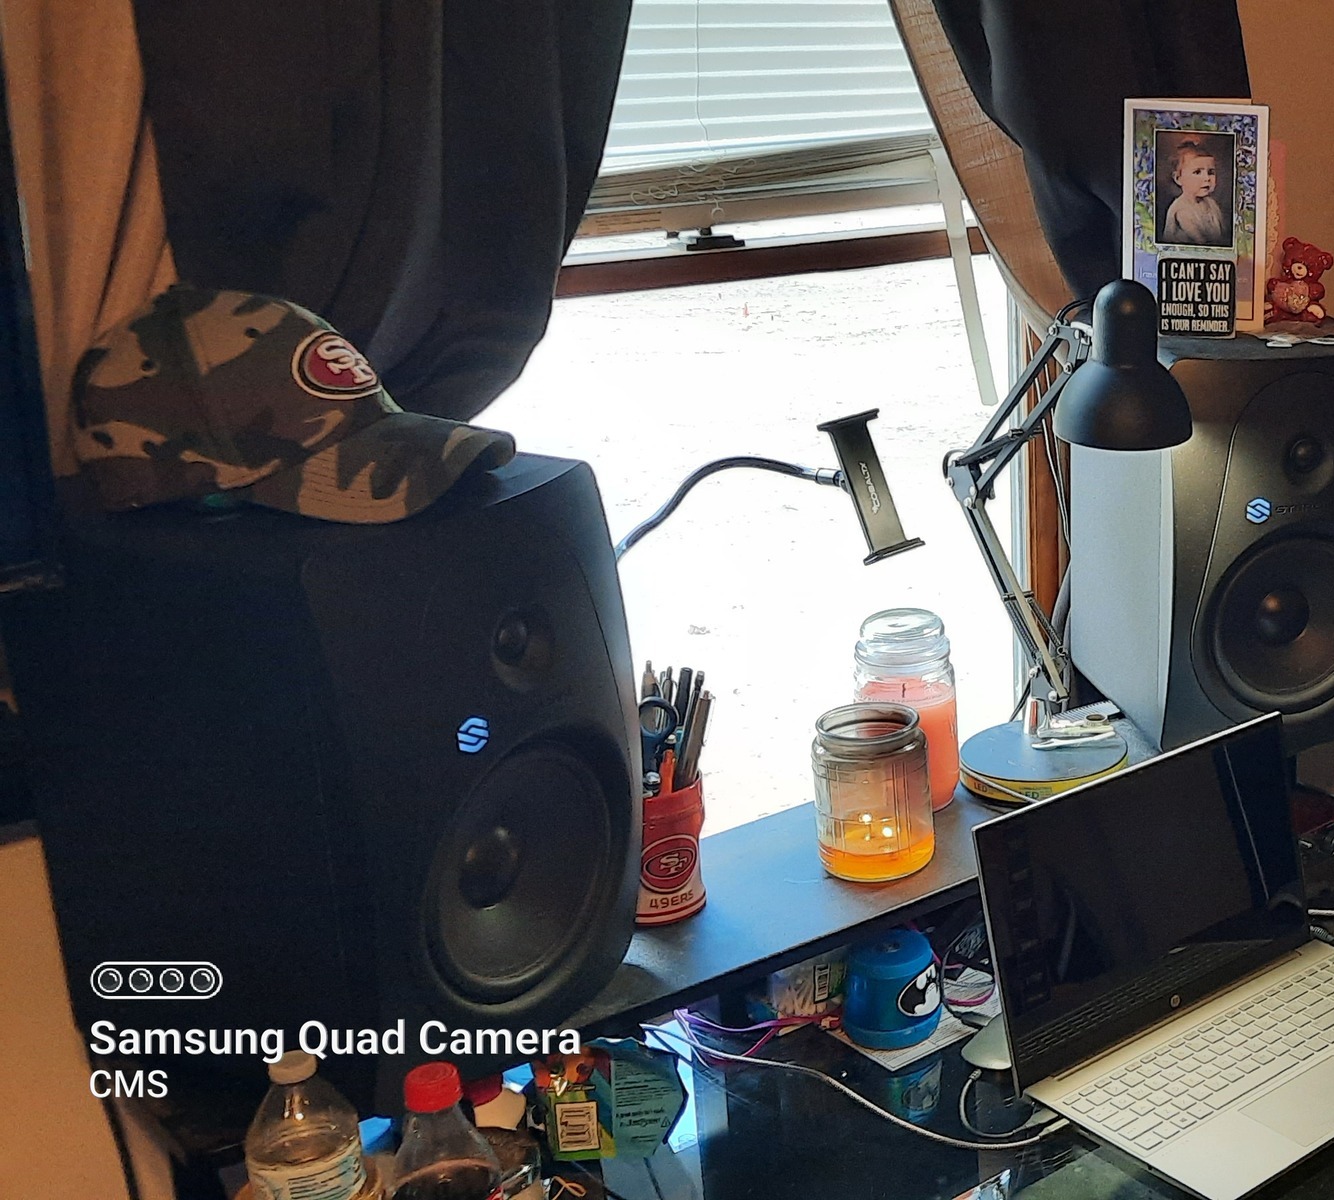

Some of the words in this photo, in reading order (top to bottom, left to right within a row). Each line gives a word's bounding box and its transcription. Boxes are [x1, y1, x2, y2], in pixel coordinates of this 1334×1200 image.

[1161, 262, 1166, 279] I
[1170, 262, 1206, 280] CAN'T
[1209, 263, 1231, 281] SAY
[1161, 281, 1166, 301] I
[1172, 281, 1202, 302] LOVE
[1205, 282, 1230, 303] YOU
[1161, 302, 1196, 318] ENOUGH,
[1198, 304, 1209, 317] SO
[1211, 304, 1229, 318] THIS
[1161, 318, 1169, 331] IS
[1170, 319, 1190, 331] YOUR
[1191, 319, 1231, 333] REMINDER.
[973, 781, 989, 794] LED
[649, 889, 695, 909] 49ERS
